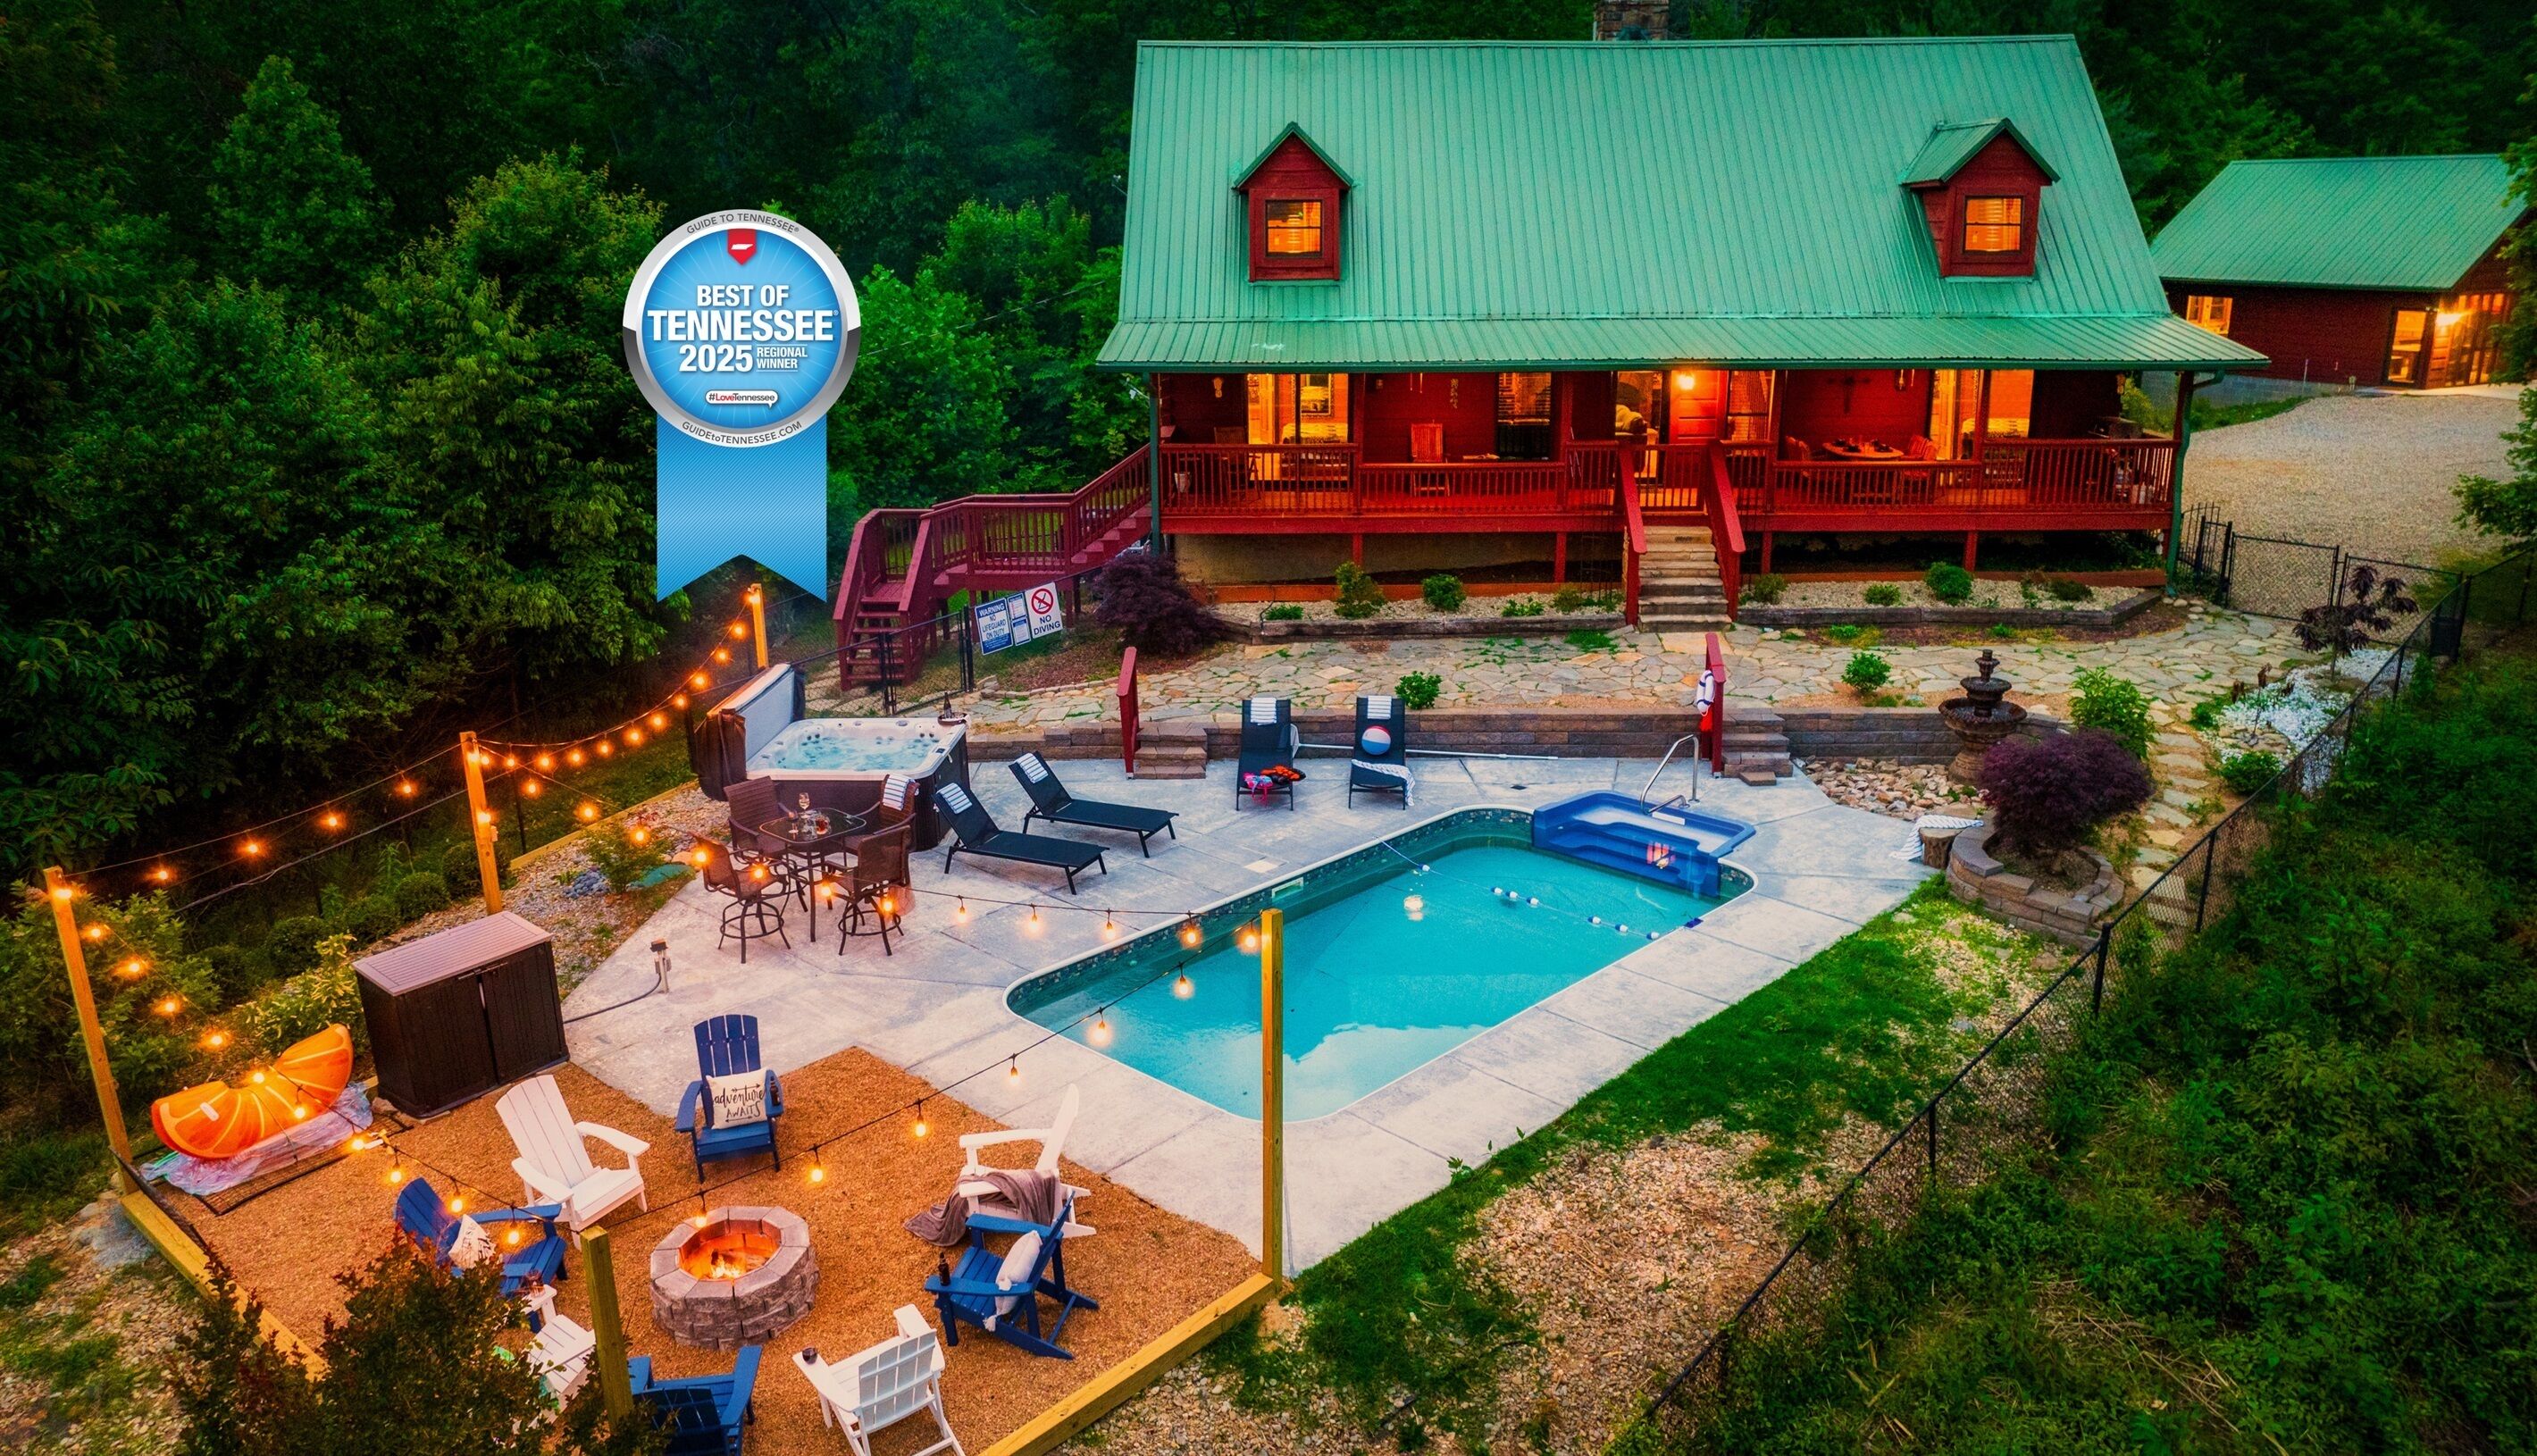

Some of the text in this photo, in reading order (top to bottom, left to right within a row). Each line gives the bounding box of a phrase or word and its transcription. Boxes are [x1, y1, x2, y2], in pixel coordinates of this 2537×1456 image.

[979, 603, 1005, 616] WARNING
[983, 619, 1006, 632] LIFEGUARD
[1040, 615, 1051, 623] NO
[986, 628, 1005, 640] ON DUTY
[1034, 621, 1060, 635] DIVING
[712, 1084, 766, 1109] adventure
[726, 1100, 761, 1117] AWAITS
